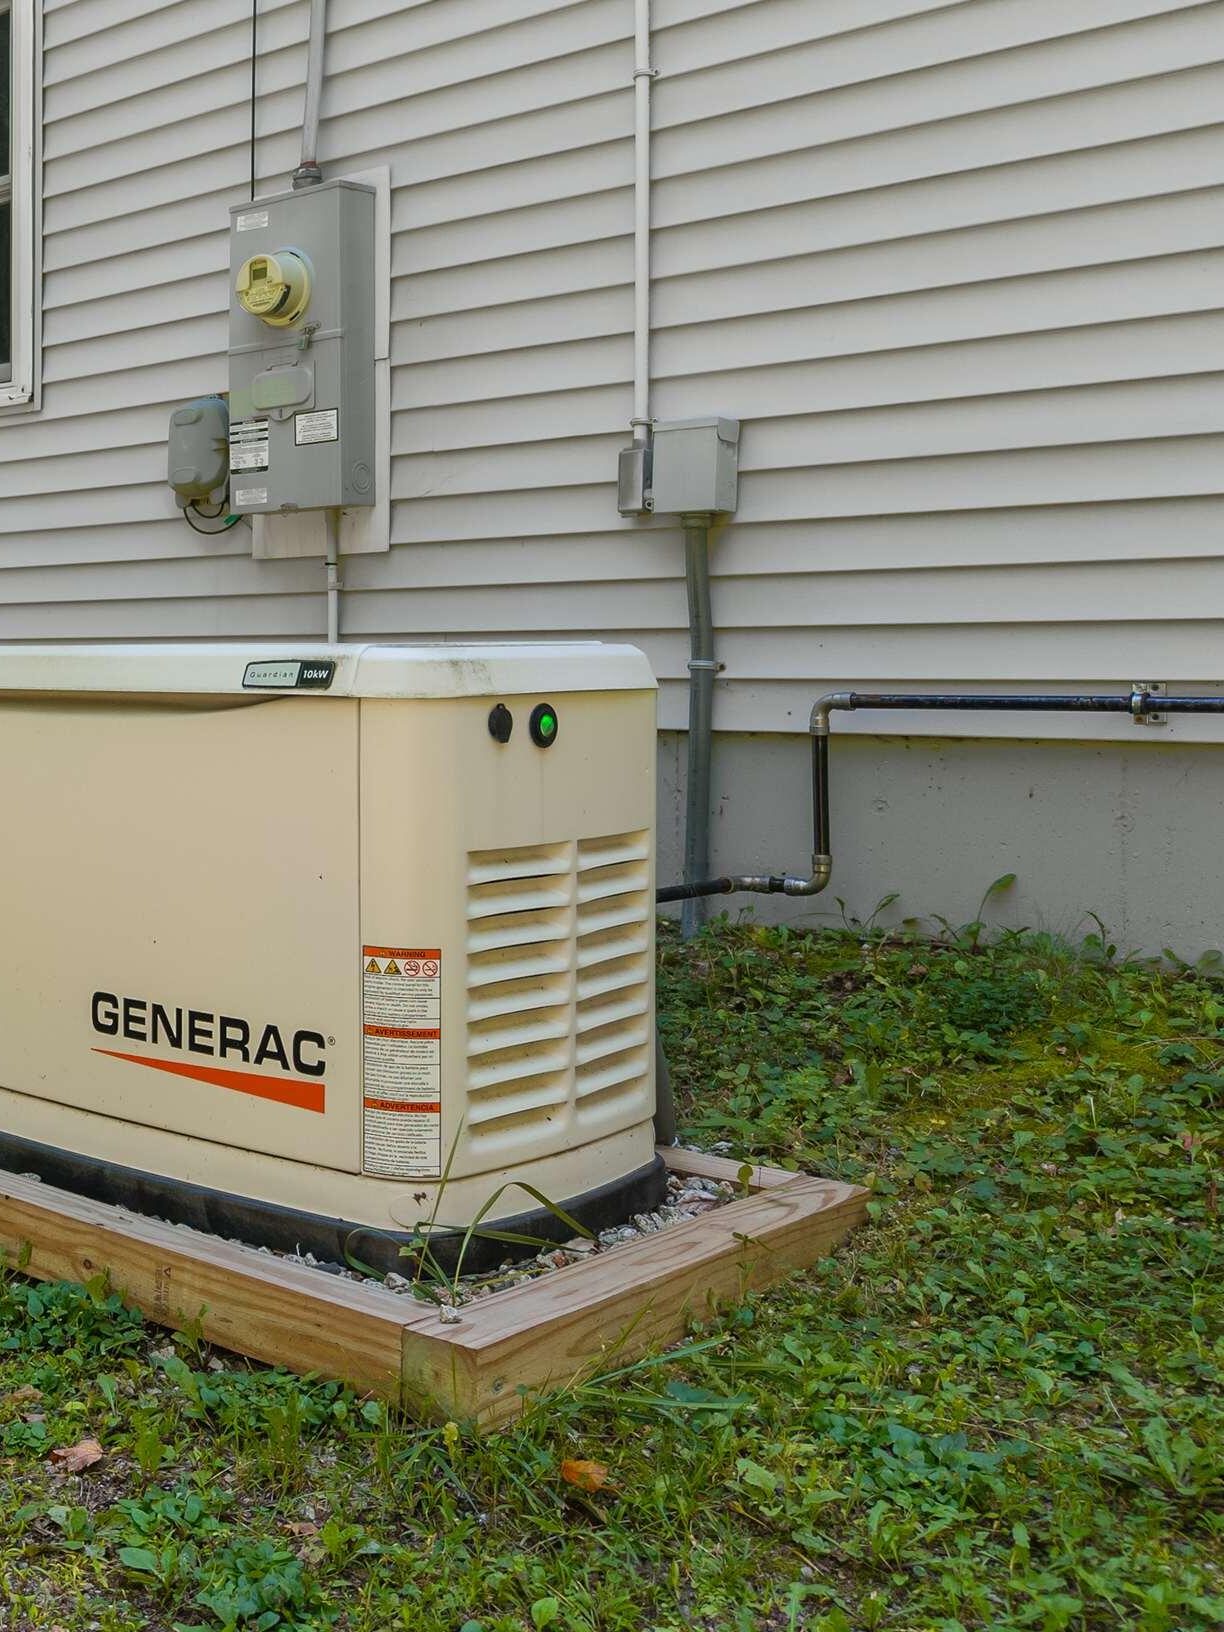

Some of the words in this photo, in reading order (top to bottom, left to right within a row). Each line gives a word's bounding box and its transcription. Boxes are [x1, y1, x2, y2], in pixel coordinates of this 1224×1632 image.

[303, 669, 329, 679] 10kW
[91, 991, 326, 1077] GENERAC
[380, 1101, 434, 1111] ADVERTENCIA
